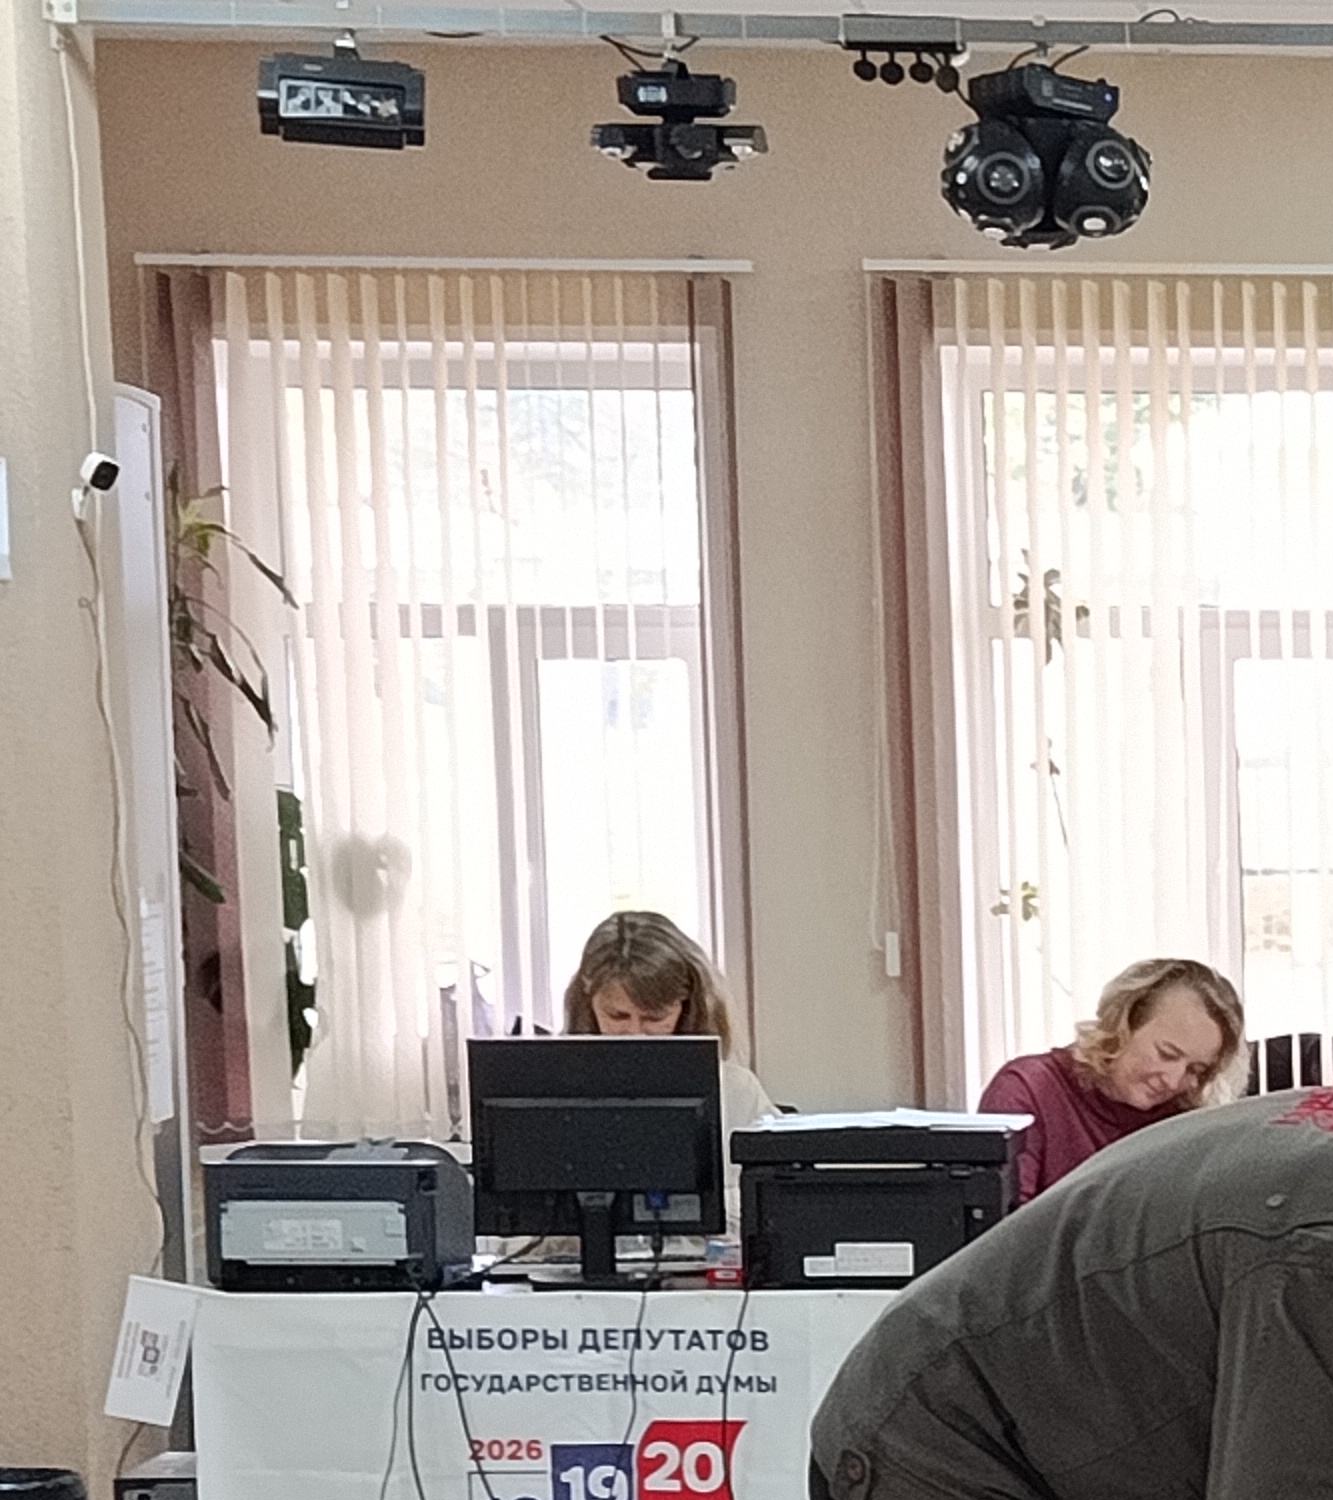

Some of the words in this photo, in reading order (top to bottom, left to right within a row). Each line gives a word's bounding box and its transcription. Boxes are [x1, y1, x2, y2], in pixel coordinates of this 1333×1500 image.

[427, 1328, 567, 1351] ВЫБОРЫ
[578, 1328, 770, 1353] ДЕПУТАТОВ
[420, 1371, 687, 1394] ГОСУДАРСТВЕННОЙ
[695, 1375, 777, 1395] ДУМЫ
[469, 1439, 543, 1460] 2026
[642, 1441, 725, 1493] 20
